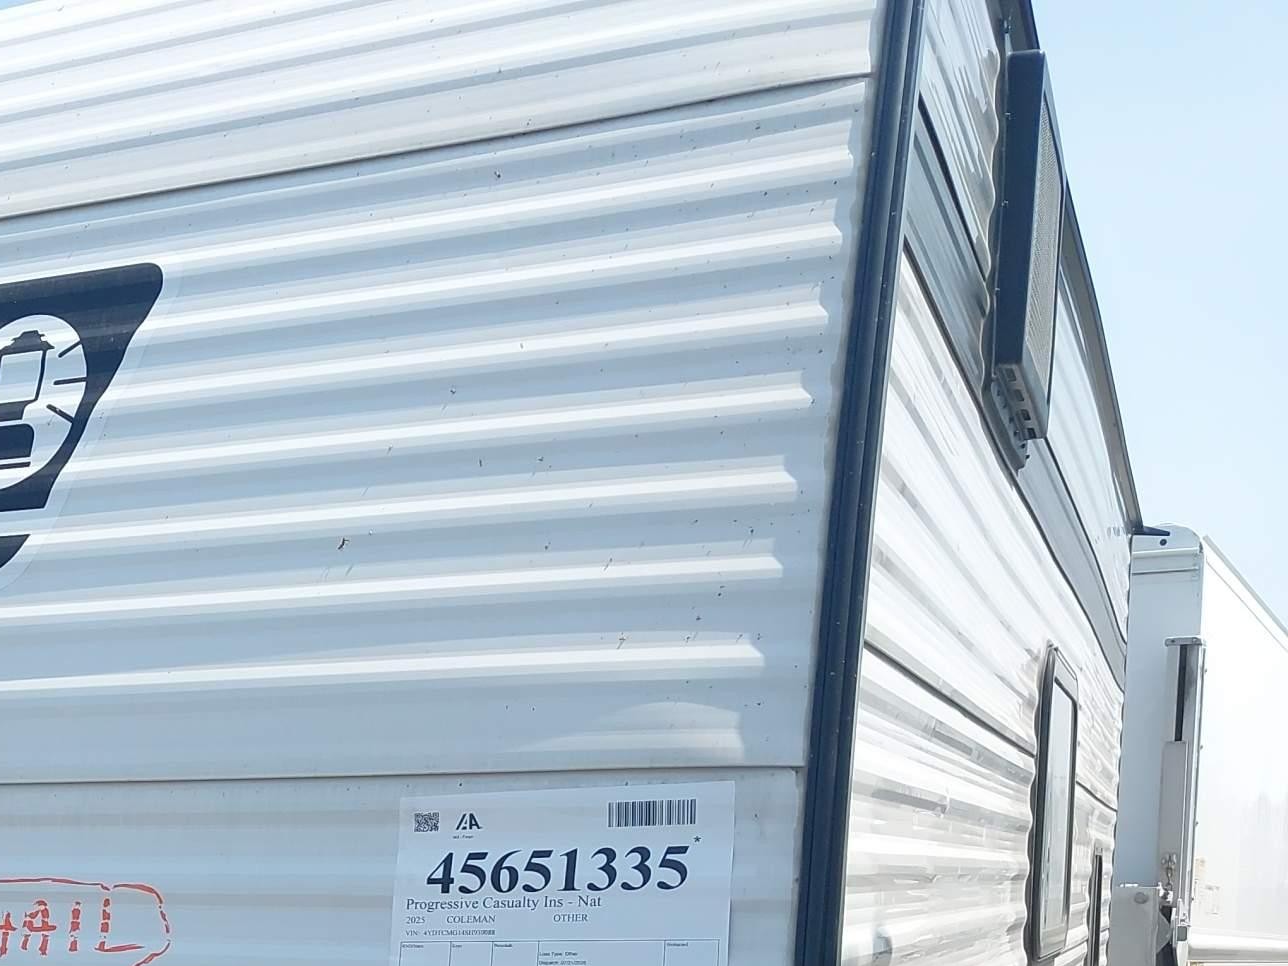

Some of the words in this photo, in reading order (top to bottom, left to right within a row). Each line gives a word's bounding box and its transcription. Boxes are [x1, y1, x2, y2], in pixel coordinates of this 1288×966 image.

[426, 845, 690, 895] 45651335
[406, 898, 479, 912] Progressive
[482, 896, 539, 911] Casualty
[544, 895, 564, 908] Ins
[577, 894, 602, 907] Nat
[406, 916, 425, 924] 2025
[446, 915, 496, 924] COLEMAN
[553, 913, 589, 922] OTHER
